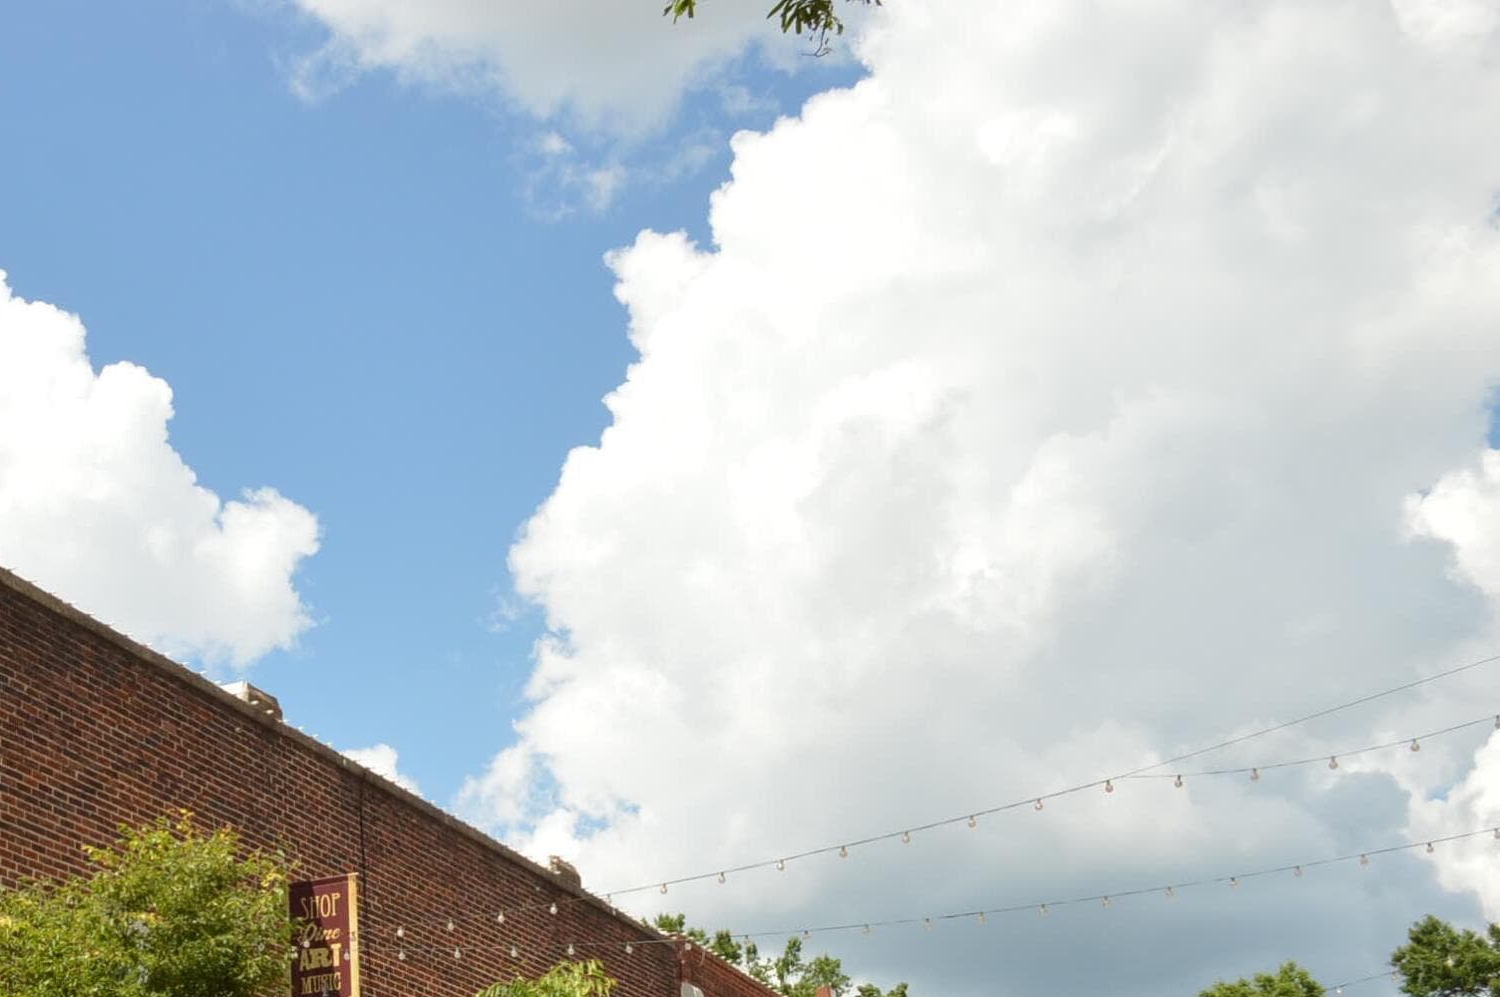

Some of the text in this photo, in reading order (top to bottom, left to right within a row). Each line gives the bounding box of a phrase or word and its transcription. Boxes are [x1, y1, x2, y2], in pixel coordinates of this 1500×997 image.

[301, 892, 341, 920] SHOP
[300, 943, 342, 971] ART
[301, 972, 342, 994] MUSIC
